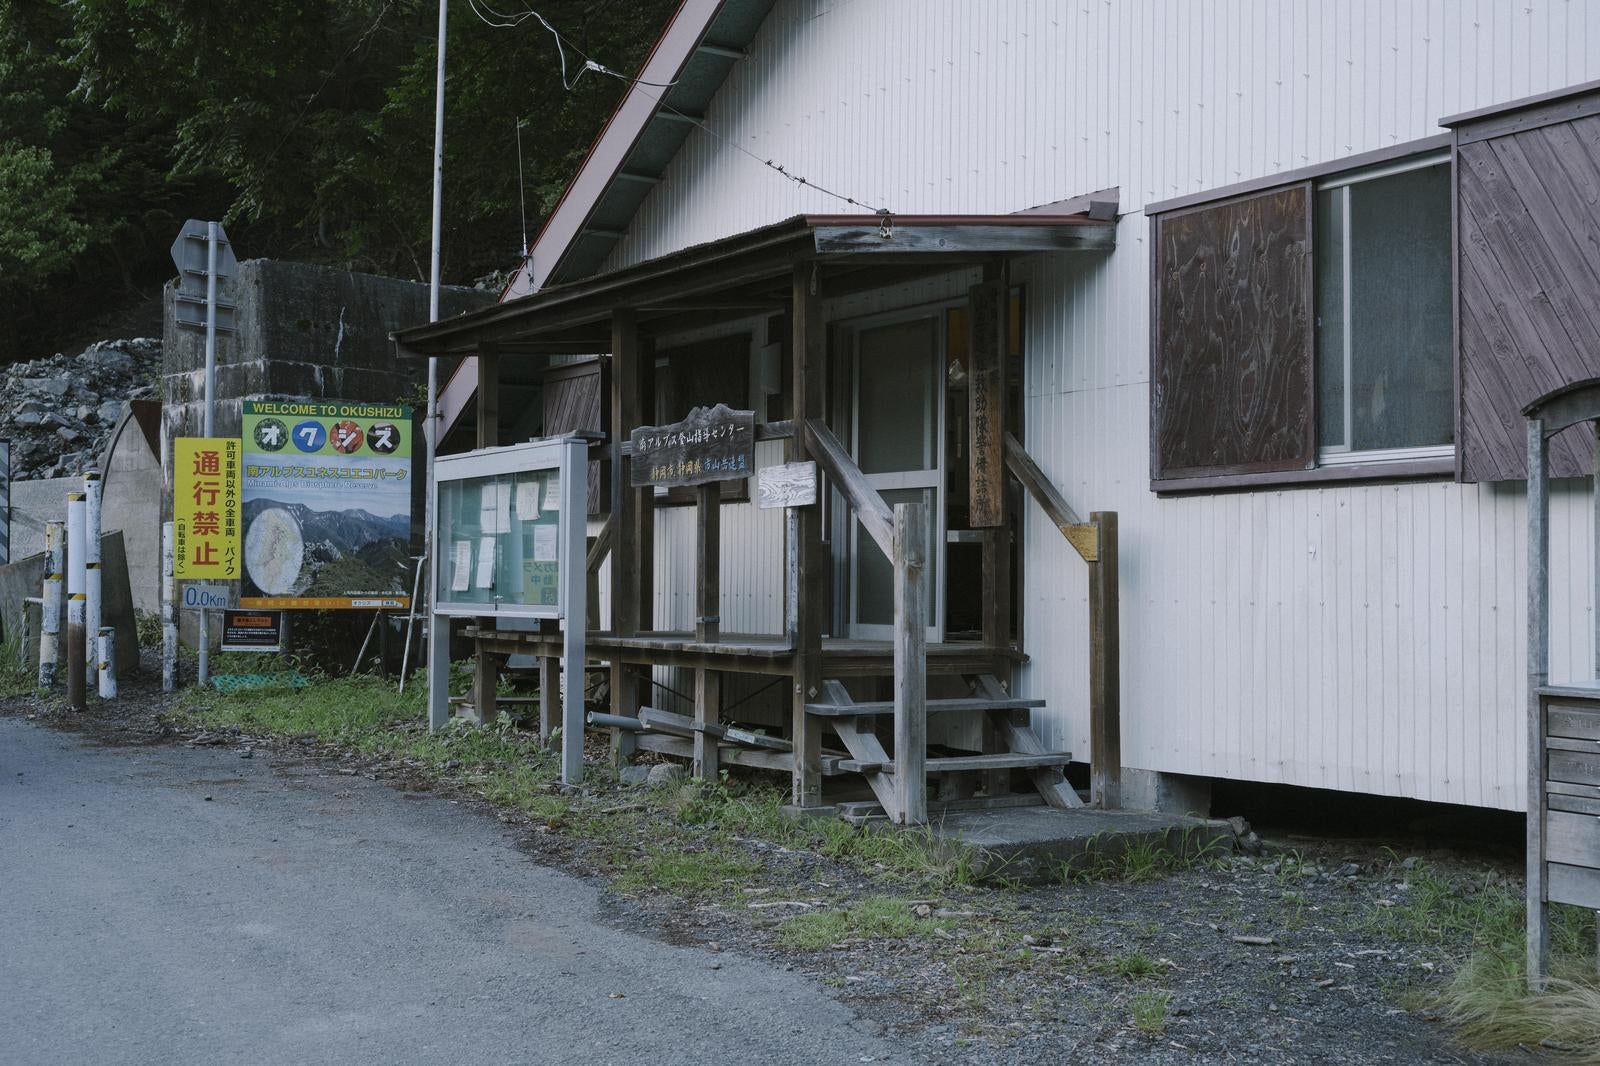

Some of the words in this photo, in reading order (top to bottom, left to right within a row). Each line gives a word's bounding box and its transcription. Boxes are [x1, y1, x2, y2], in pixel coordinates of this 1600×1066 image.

[253, 403, 316, 415] WELCOME
[317, 405, 336, 416] TO
[340, 406, 402, 418] OKUSHIZU
[261, 425, 393, 449] オクシズ
[247, 465, 407, 480] 南アルプスユネスコエコパーク
[192, 450, 221, 566] 通行禁止
